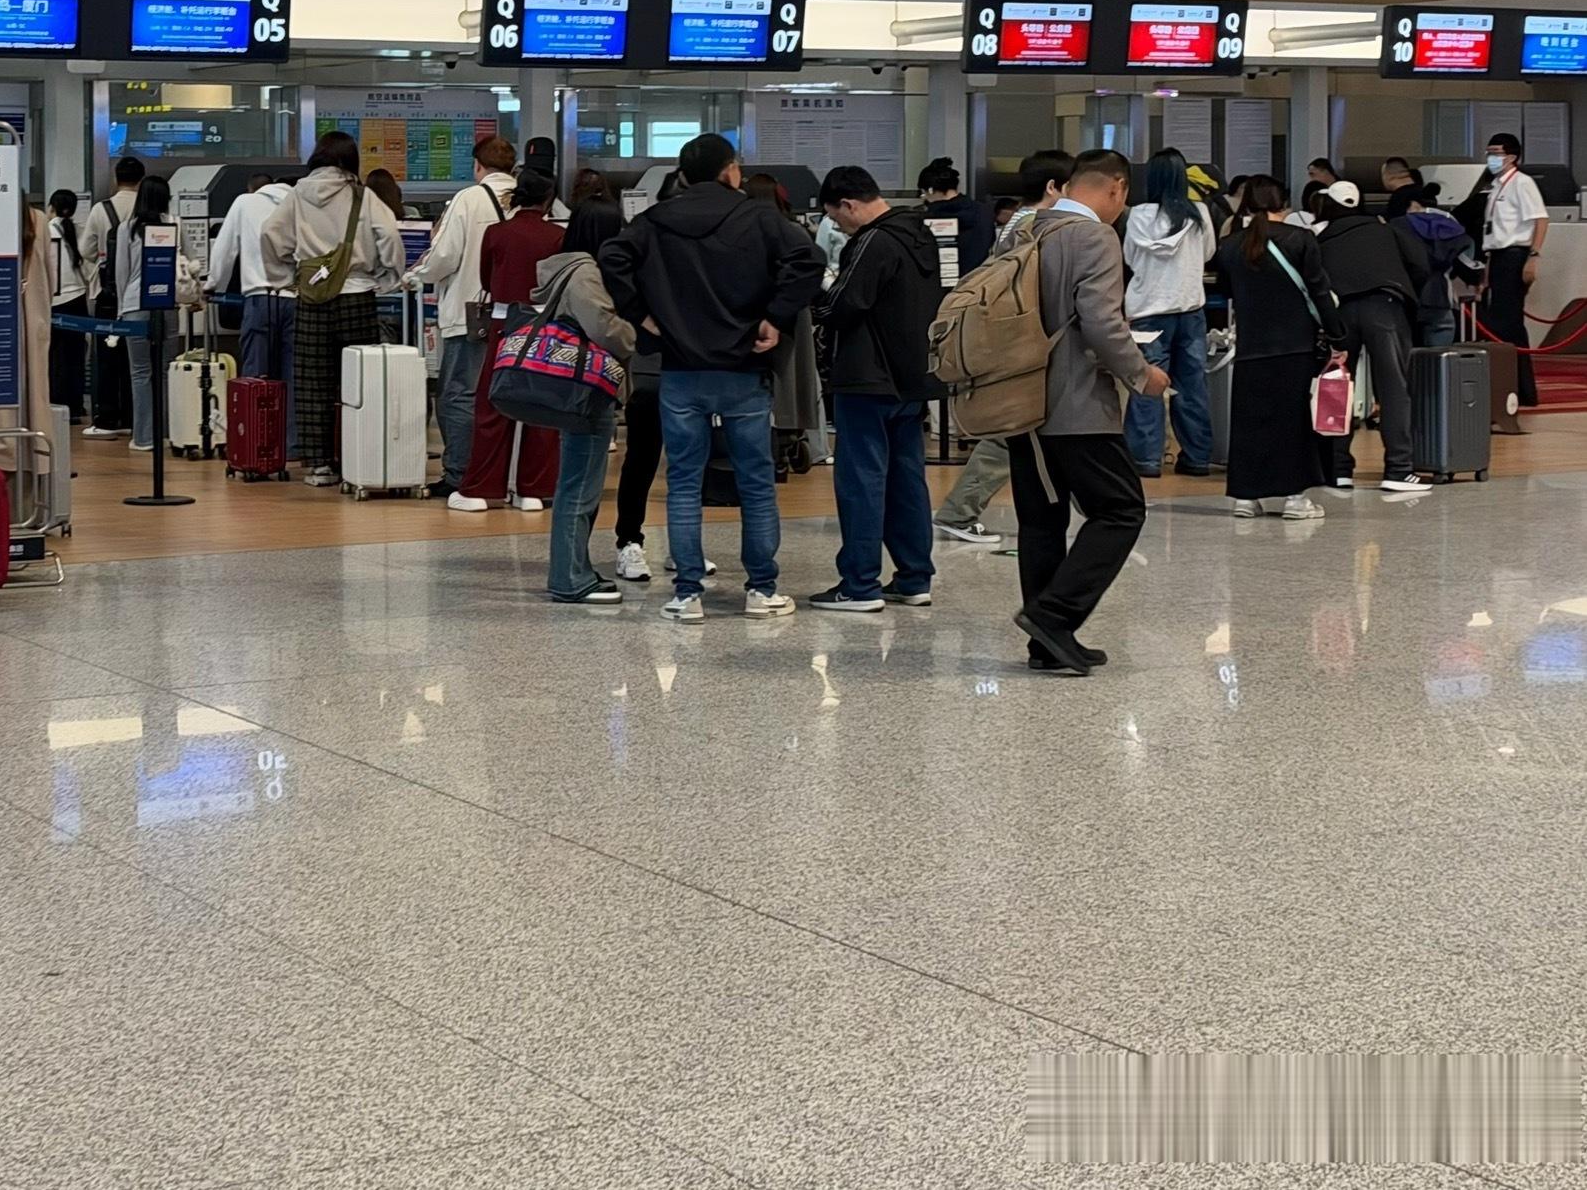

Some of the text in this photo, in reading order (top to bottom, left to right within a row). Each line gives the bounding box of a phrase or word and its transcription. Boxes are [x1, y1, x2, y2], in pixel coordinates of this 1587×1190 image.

[779, 3, 797, 25] Q
[979, 8, 995, 29] Q
[1225, 12, 1240, 33] Q
[253, 17, 286, 42] 05
[489, 24, 519, 48] 06
[1397, 18, 1413, 38] Q
[772, 29, 801, 53] 07
[971, 34, 998, 55] 08
[1217, 37, 1243, 59] 09
[1392, 41, 1414, 62] 10
